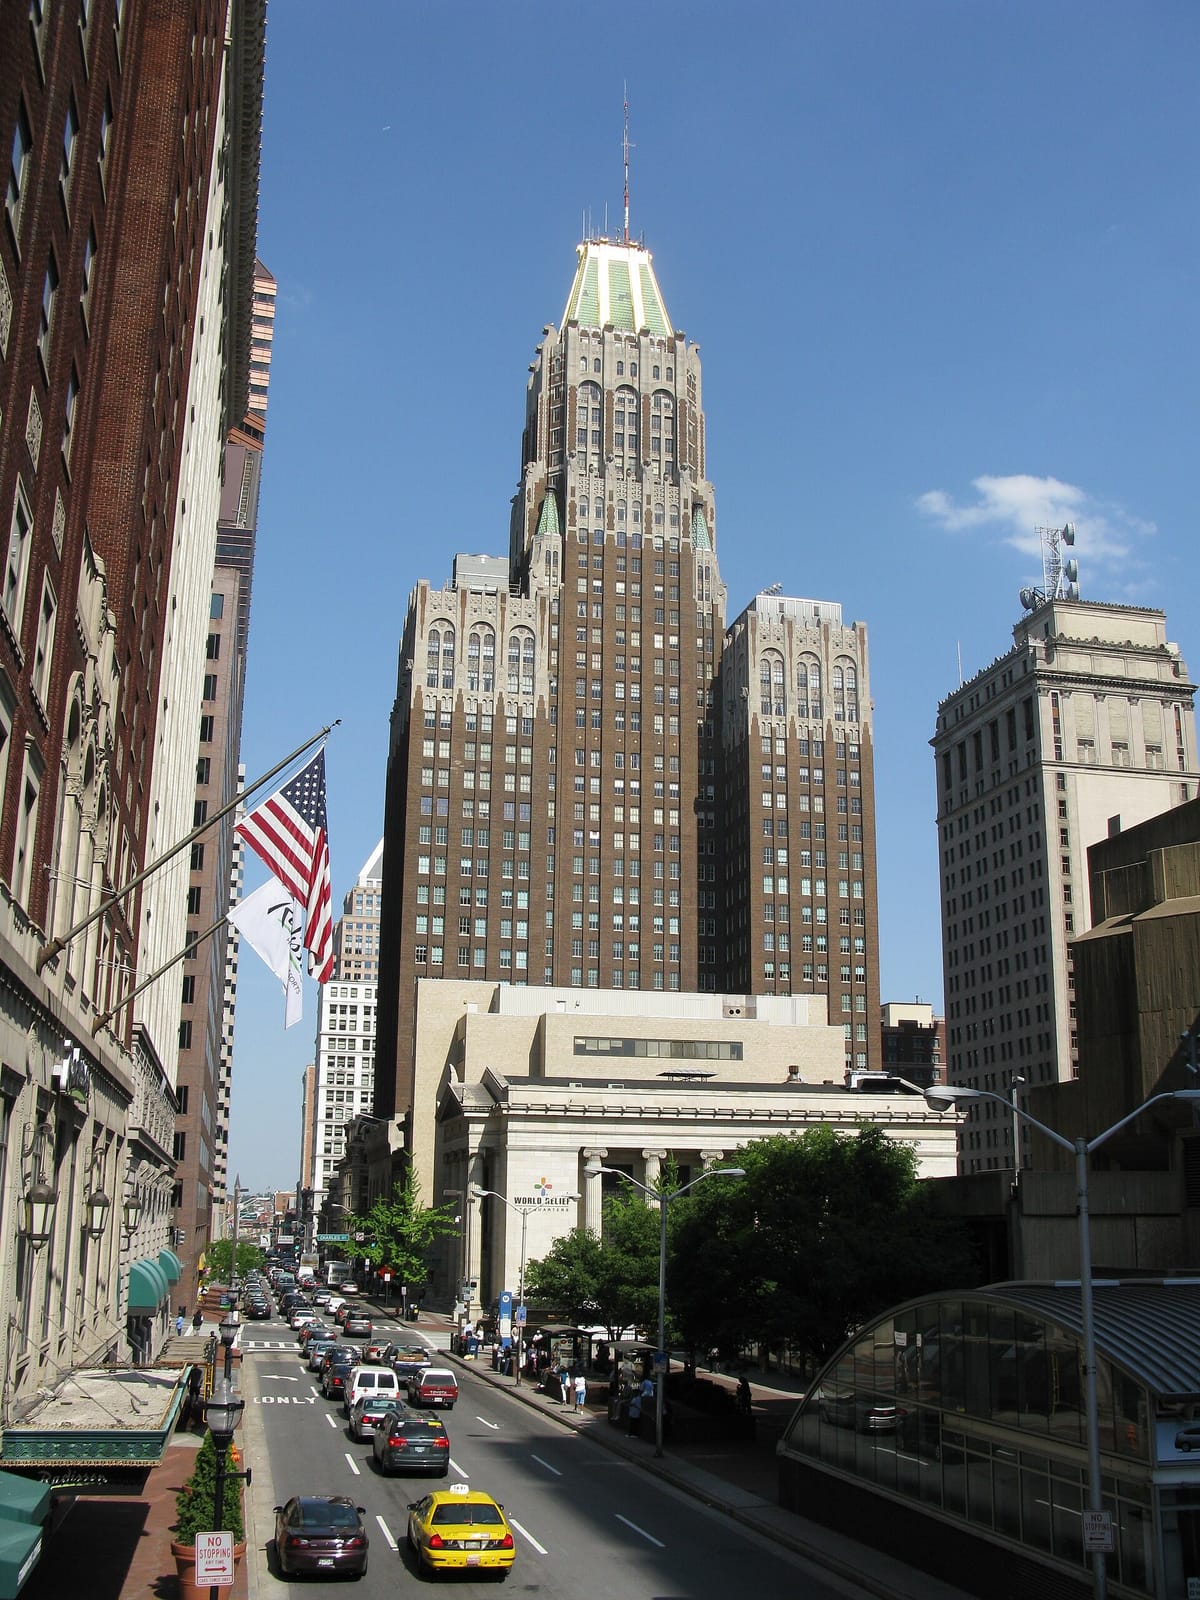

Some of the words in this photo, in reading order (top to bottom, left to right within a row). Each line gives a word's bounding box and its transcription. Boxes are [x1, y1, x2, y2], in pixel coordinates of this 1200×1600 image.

[261, 1396, 316, 1404] ONLY
[1090, 1513, 1103, 1522] NO
[207, 1536, 222, 1547] NO
[199, 1547, 231, 1559] STOPPING
